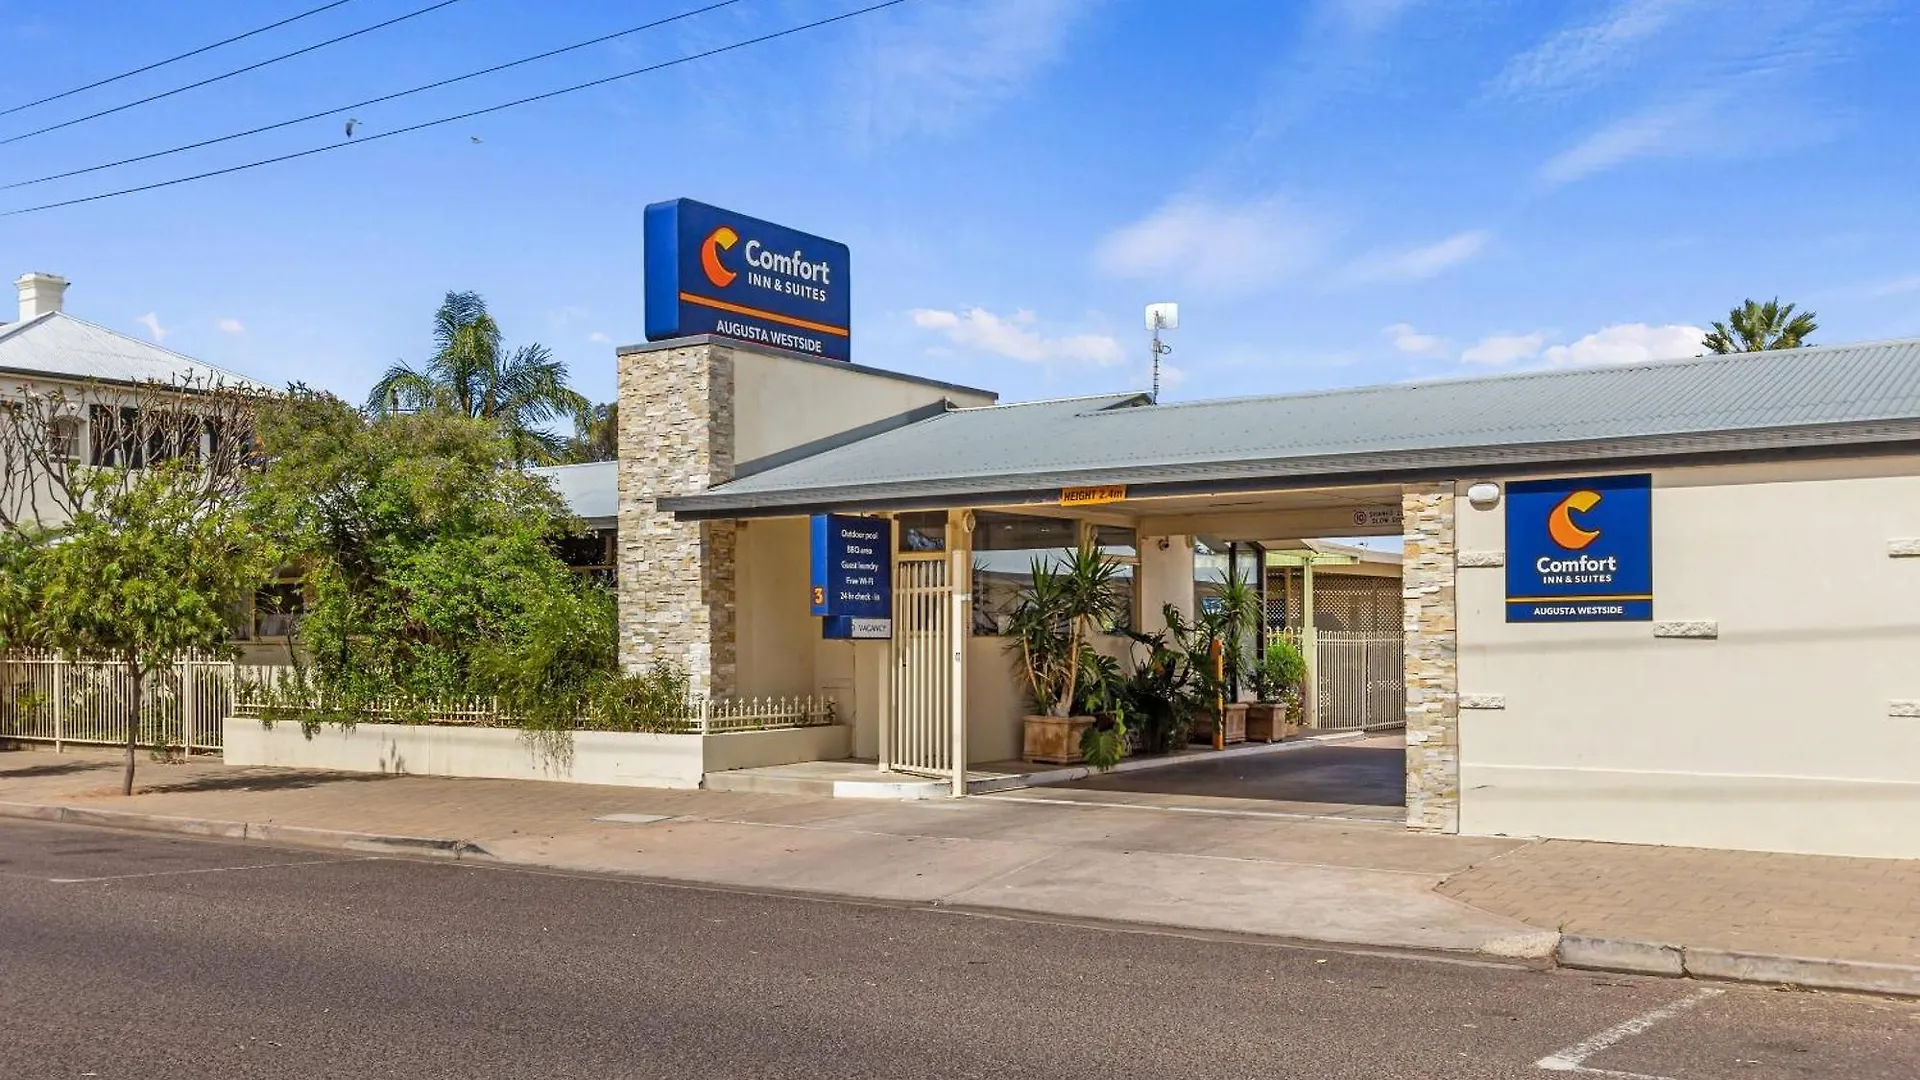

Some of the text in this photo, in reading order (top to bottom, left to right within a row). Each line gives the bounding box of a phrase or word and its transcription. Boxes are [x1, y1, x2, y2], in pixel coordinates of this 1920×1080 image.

[745, 239, 830, 285] Comfort
[748, 272, 826, 302] INN & SUITES
[716, 320, 822, 353] AUGUSTA WESTSIDE
[1064, 489, 1097, 502] HEIGHT
[841, 529, 878, 540] Outdoor pool
[847, 545, 860, 554] BBQ
[841, 561, 879, 572] Guest laundry
[1536, 555, 1617, 573] Comfort
[846, 577, 858, 585] Free
[1543, 574, 1612, 584] INN & SUITES
[814, 588, 823, 604] 3
[840, 592, 848, 600] 24
[1534, 606, 1623, 616] AUGUSTA WESTSIDE
[858, 624, 887, 632] VACANCY
